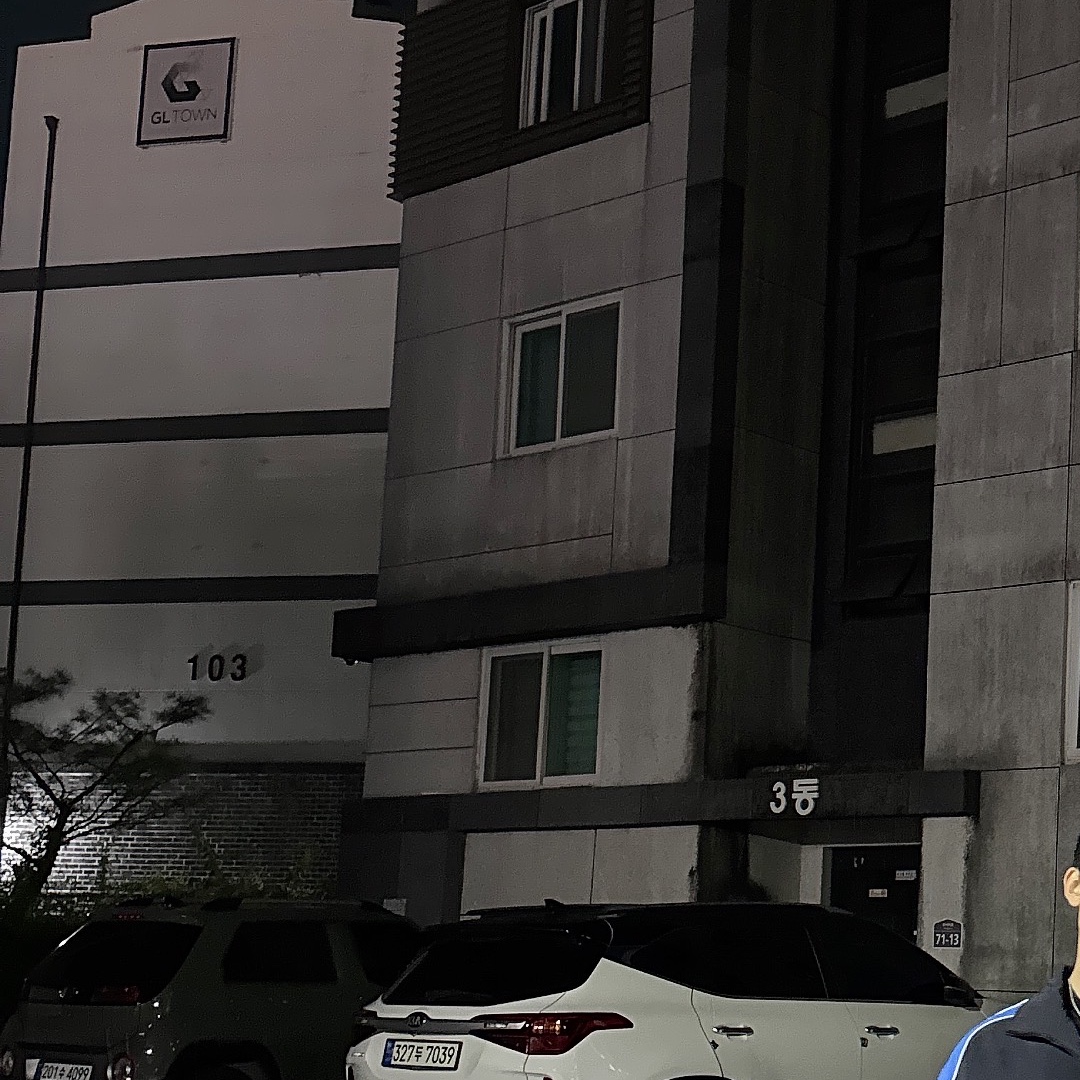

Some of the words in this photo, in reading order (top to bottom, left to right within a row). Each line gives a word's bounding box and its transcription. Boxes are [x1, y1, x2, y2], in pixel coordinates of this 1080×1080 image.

[150, 111, 171, 124] GL
[172, 108, 218, 123] TOWN
[187, 653, 248, 682] 103
[769, 777, 821, 817] 3동
[935, 932, 960, 947] 71-13
[393, 1044, 424, 1063] 327두
[425, 1046, 456, 1065] 7039
